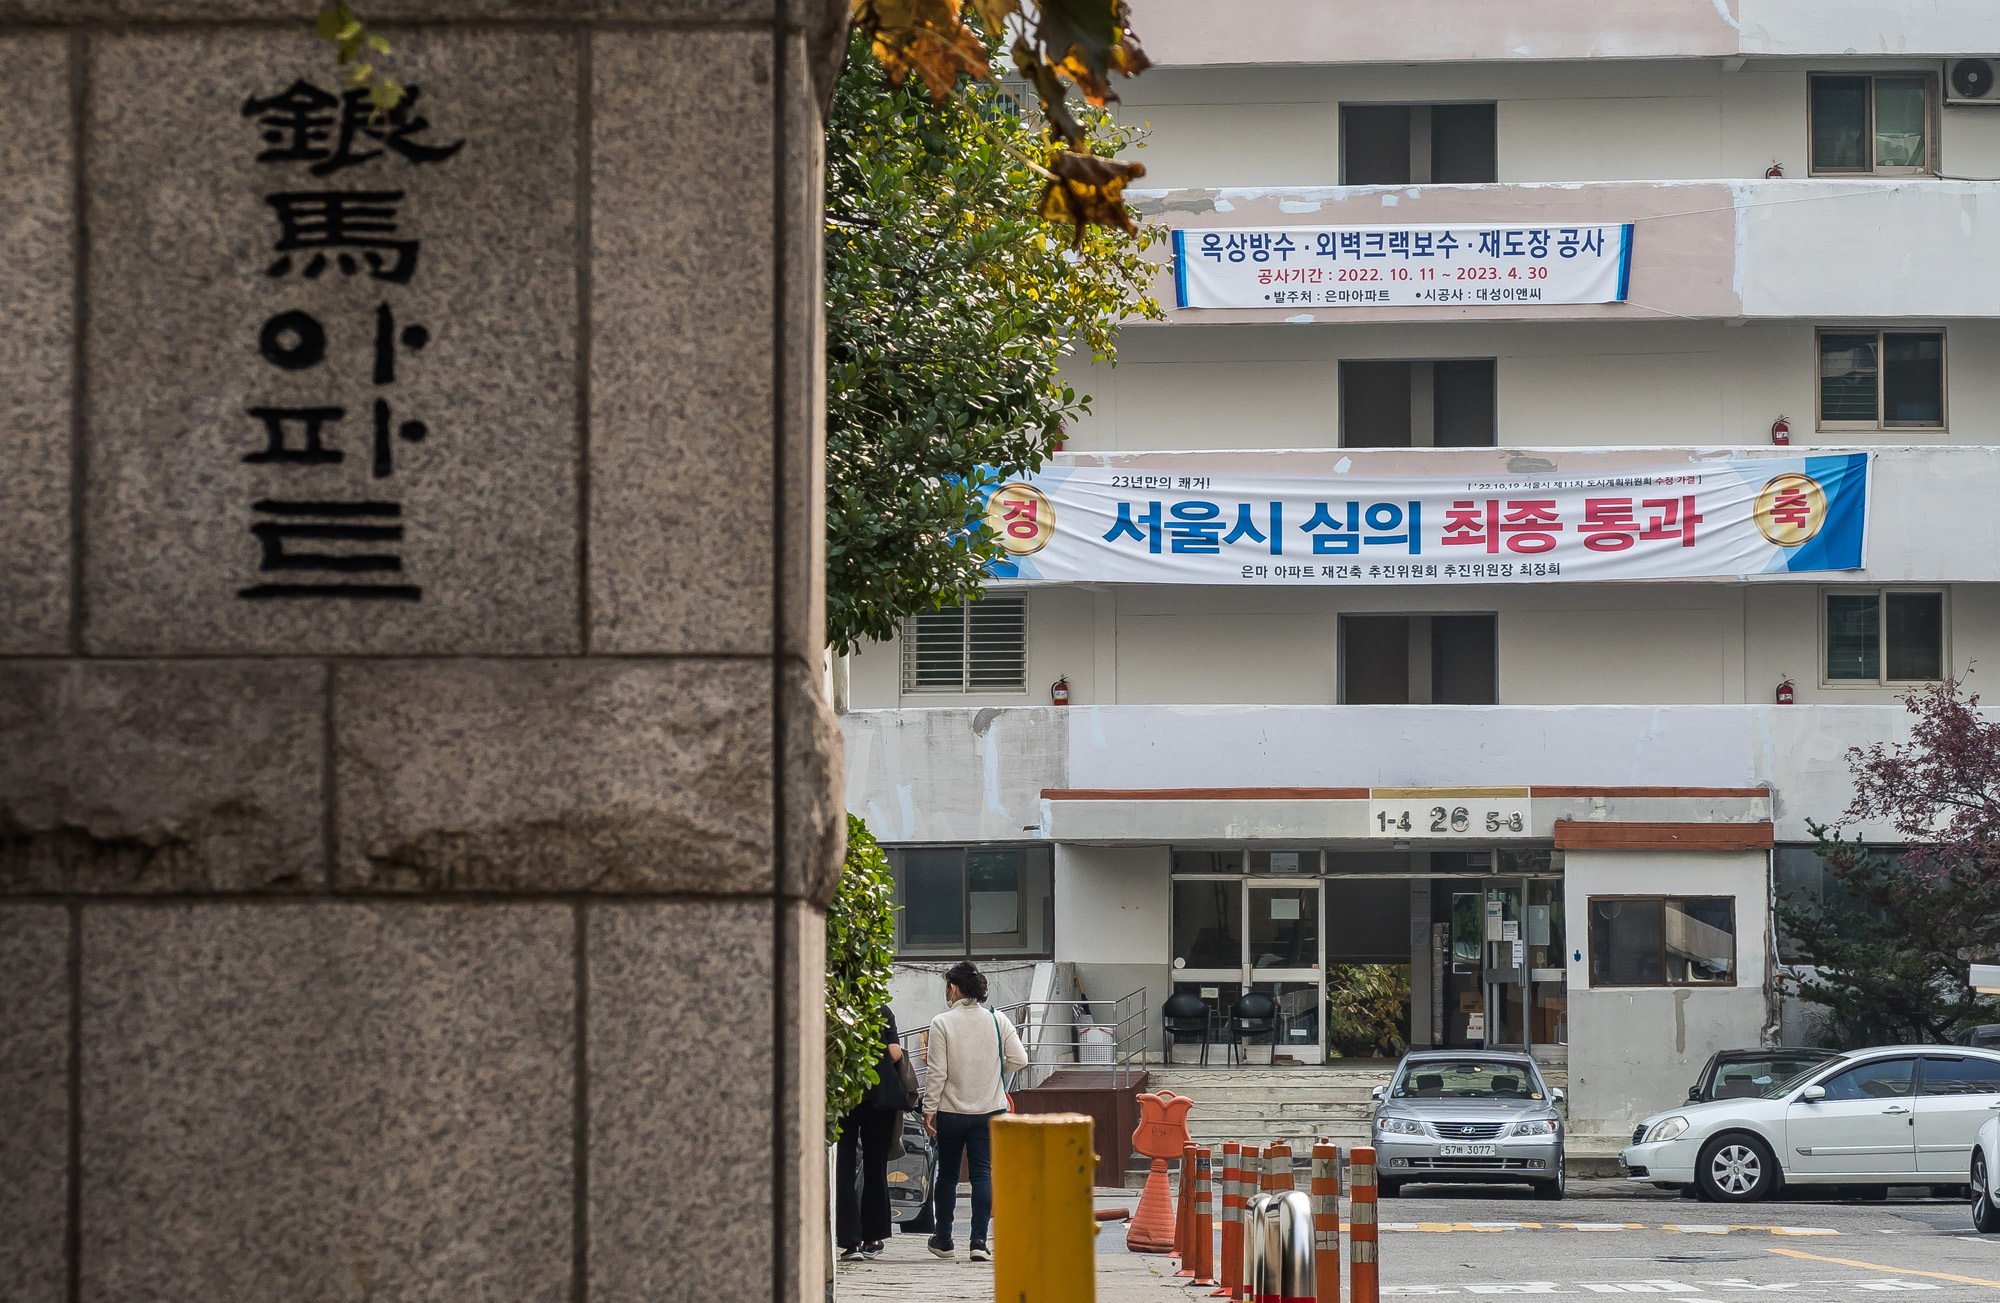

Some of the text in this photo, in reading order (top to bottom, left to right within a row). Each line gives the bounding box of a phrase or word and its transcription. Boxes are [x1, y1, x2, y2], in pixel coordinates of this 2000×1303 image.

[1200, 232, 1297, 263] 옥상방수
[1315, 230, 1460, 261] 외벽크랙보수
[1478, 229, 1550, 259] 재도장
[1557, 229, 1605, 258] 공사
[1257, 267, 1324, 285] 공사기간
[1338, 268, 1384, 282] 2022.
[1390, 268, 1413, 281] 10.
[1419, 267, 1434, 281] 11
[1456, 267, 1502, 280] 2023.
[1507, 266, 1522, 280] 4.
[1528, 266, 1548, 280] 30
[1274, 290, 1313, 304] 발주처
[1324, 289, 1391, 303] 은마아파트
[1424, 288, 1463, 302] 시공사
[1476, 287, 1542, 301] 대성이앤씨
[1111, 475, 1211, 490] 23년만의 쾌거!
[1522, 481, 1550, 489] 서울시
[1553, 480, 1583, 489] 제11차
[1586, 476, 1652, 488] 도시계획위원회
[1654, 476, 1674, 486] 수정
[1676, 475, 1695, 485] 가결
[1769, 488, 1811, 529] 축
[1002, 499, 1039, 540] 경
[1102, 495, 1703, 557] 서울시 심의 최종 통과
[1241, 562, 1561, 579] 은마 아파트 재건축 추진위원회 추진위원장 최정희
[1377, 811, 1412, 832] 1-4
[1430, 806, 1469, 833] 26
[1467, 1145, 1491, 1155] 3077
